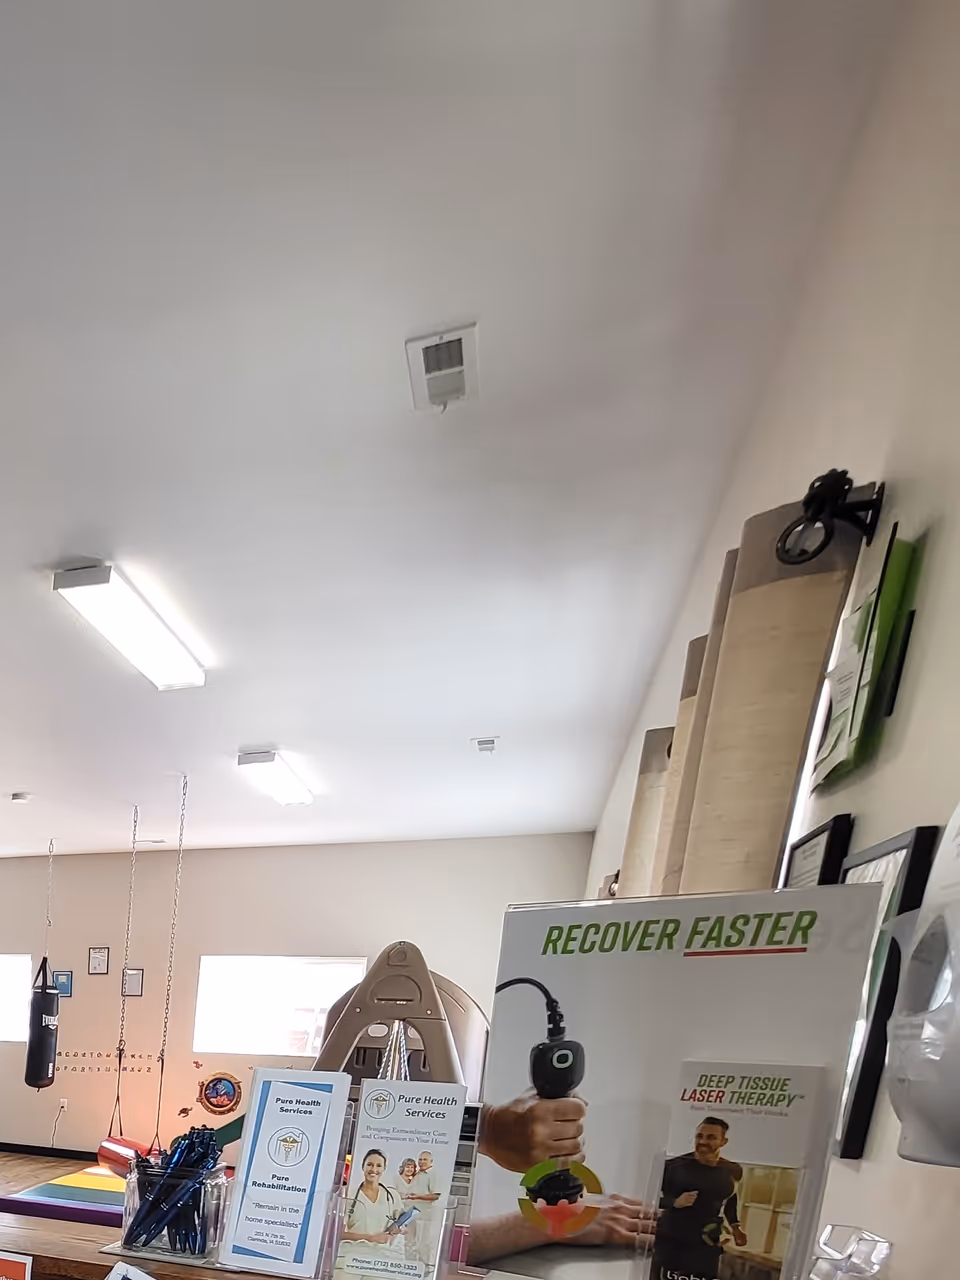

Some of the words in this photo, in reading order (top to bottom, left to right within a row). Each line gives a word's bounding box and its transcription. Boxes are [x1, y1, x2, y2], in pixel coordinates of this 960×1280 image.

[541, 919, 680, 955] RECOVER
[685, 911, 817, 949] FASTER
[697, 1074, 735, 1088] DEEP
[738, 1076, 791, 1091] TISSUE
[398, 1095, 421, 1104] Pure
[423, 1096, 457, 1106] Health
[681, 1089, 725, 1103] LASER
[279, 1107, 313, 1115] Services
[405, 1108, 446, 1119] Services
[252, 1181, 306, 1193] Rehabilitation
[289, 1206, 299, 1214] the
